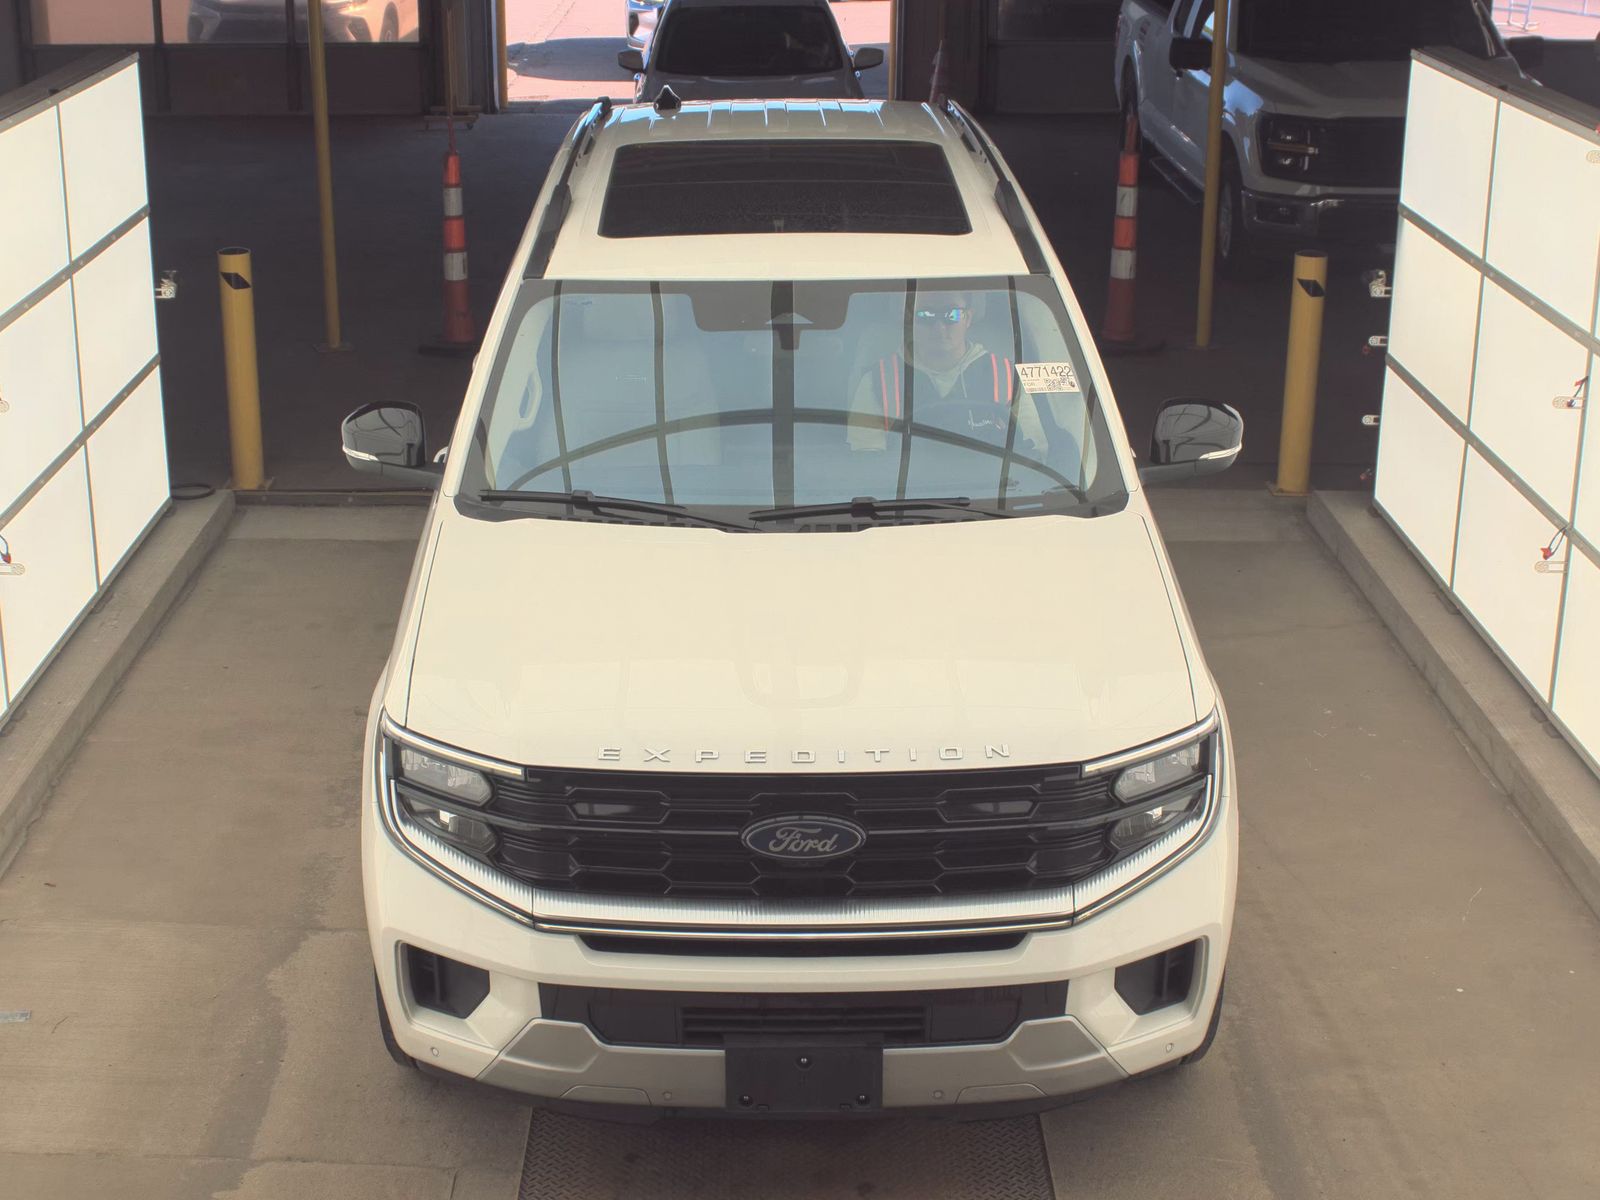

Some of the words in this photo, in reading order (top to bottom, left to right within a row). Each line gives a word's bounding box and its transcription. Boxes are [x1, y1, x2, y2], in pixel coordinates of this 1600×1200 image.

[1021, 366, 1073, 377] 4771422
[598, 744, 1010, 764] EXPEDITION
[768, 826, 838, 853] Ford
